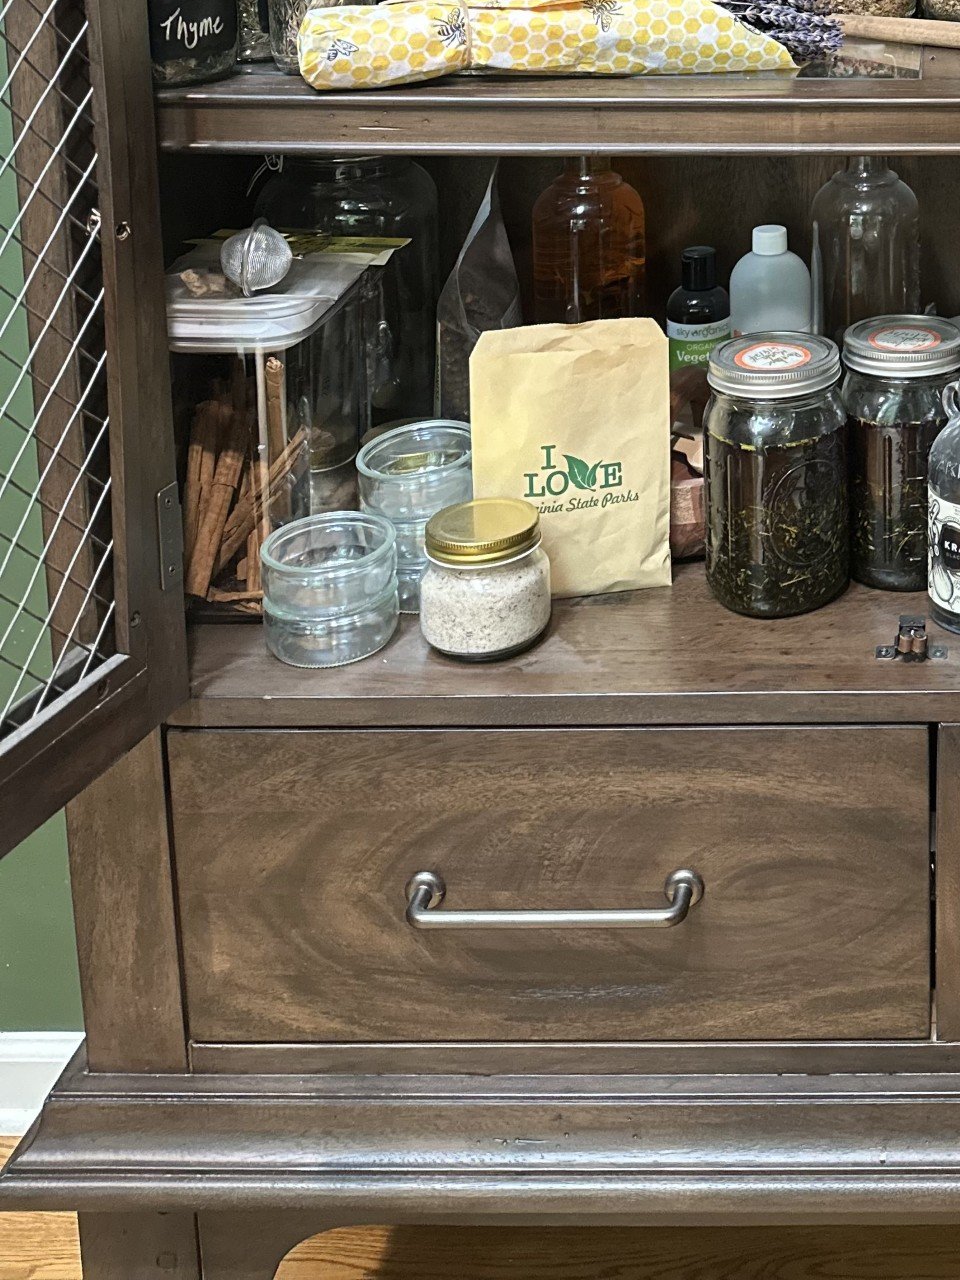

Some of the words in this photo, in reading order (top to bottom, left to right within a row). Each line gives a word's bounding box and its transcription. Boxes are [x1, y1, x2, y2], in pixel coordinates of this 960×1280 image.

[160, 7, 224, 49] Thyme
[676, 327, 690, 338] sky
[540, 444, 557, 470] I
[566, 495, 599, 513] State
[601, 489, 639, 508] Parks
